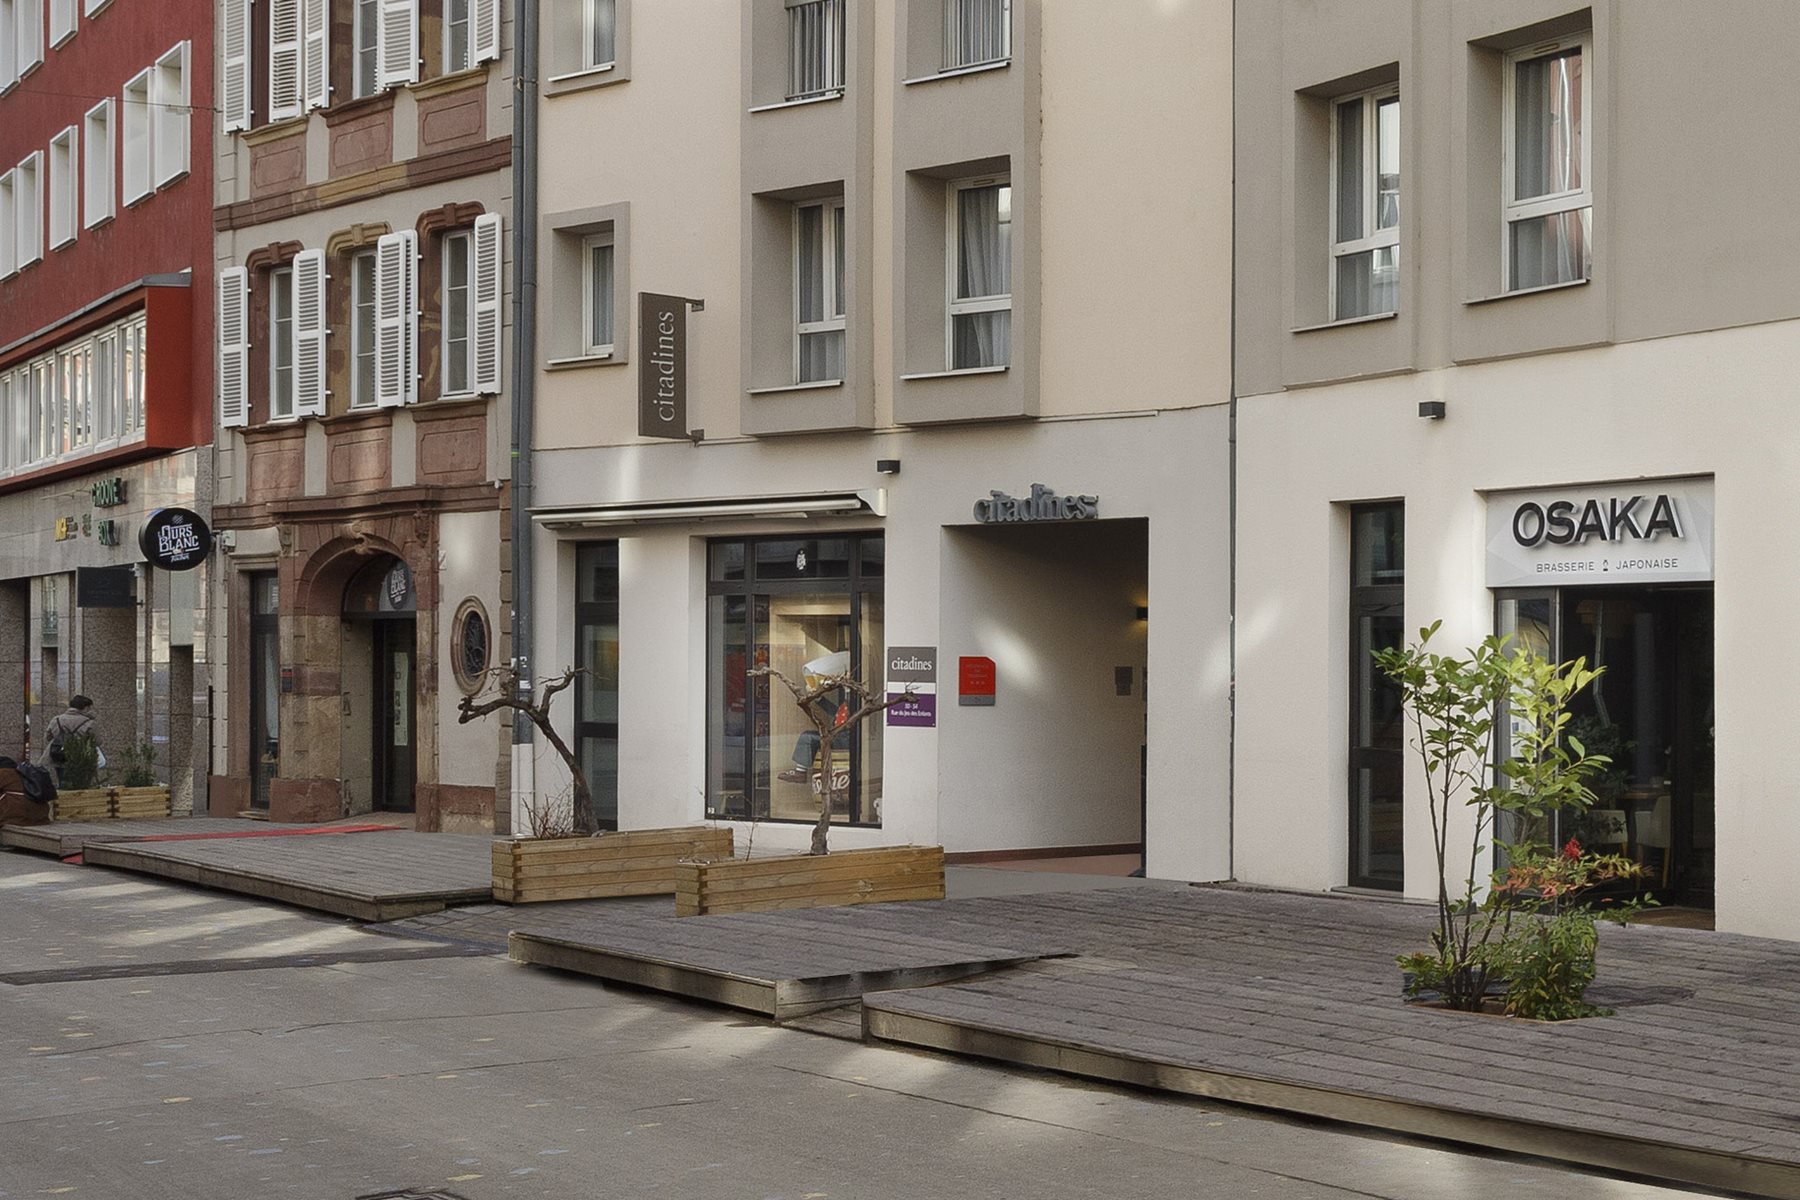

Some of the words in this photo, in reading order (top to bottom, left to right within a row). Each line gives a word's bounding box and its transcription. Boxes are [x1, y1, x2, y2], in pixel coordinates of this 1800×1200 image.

[650, 311, 675, 422] citadines
[973, 483, 1098, 523] citadines
[1512, 494, 1684, 548] OSAKA
[159, 535, 199, 552] BLANC
[1536, 561, 1595, 573] BRASSERIE
[1615, 558, 1679, 570] JAPONAISE
[891, 656, 932, 671] citadines
